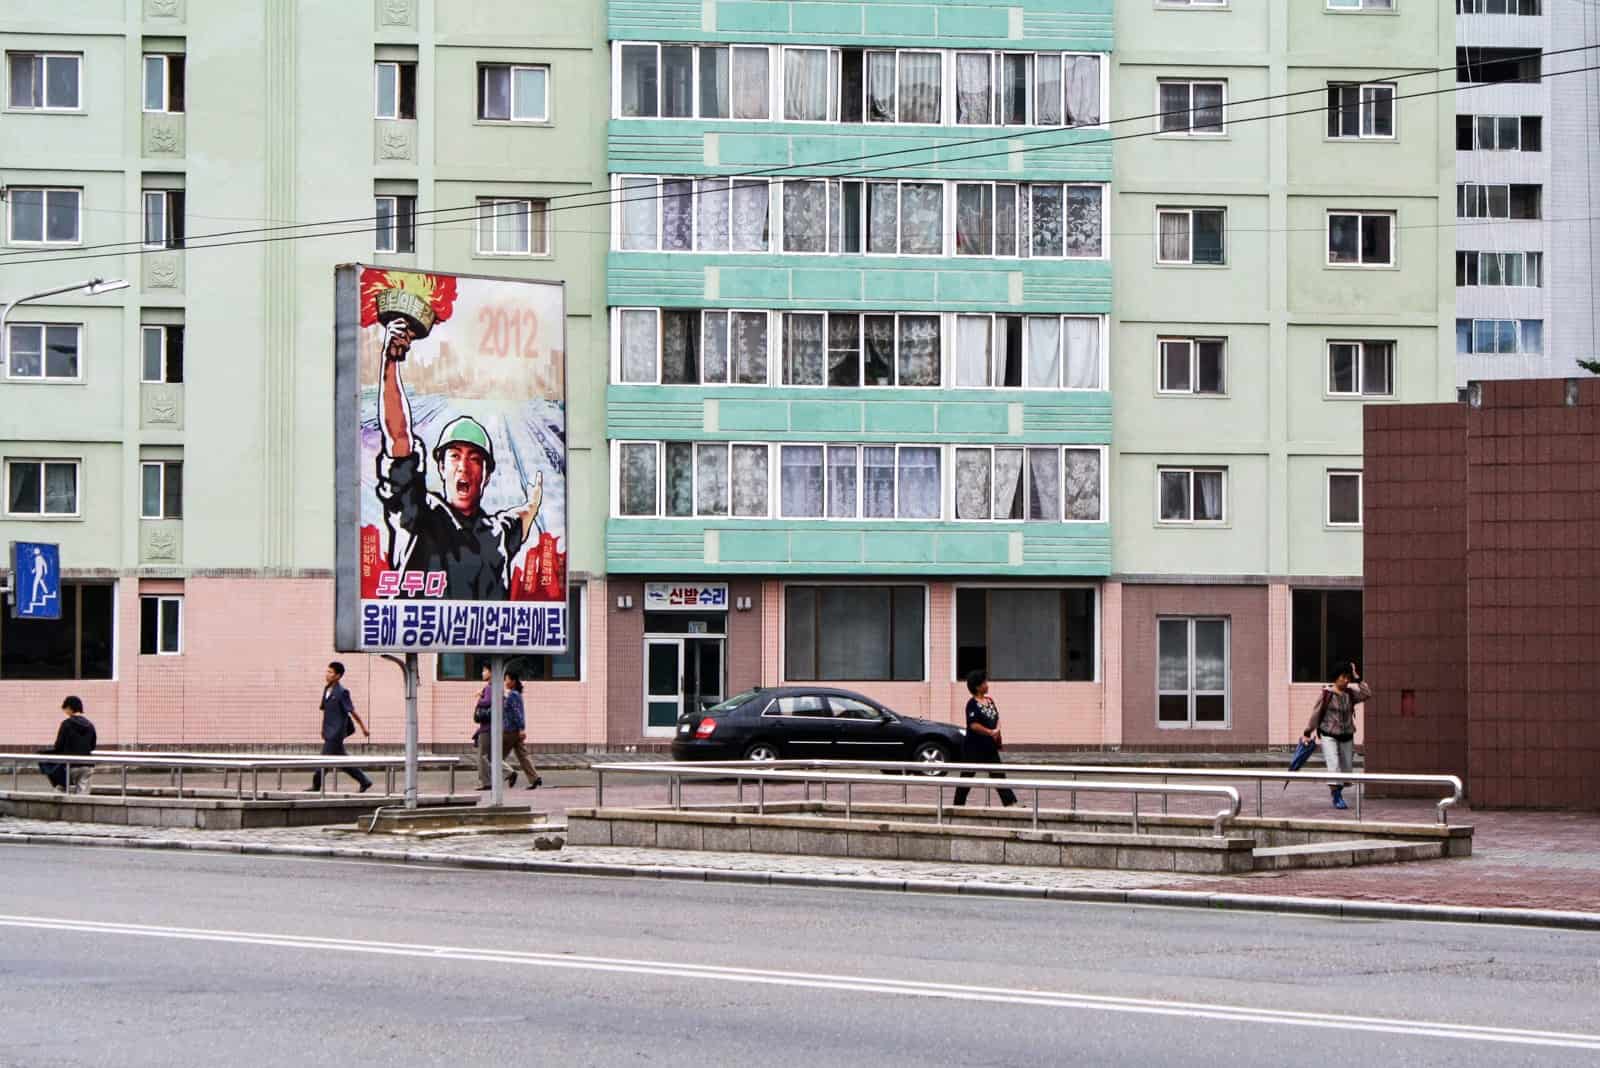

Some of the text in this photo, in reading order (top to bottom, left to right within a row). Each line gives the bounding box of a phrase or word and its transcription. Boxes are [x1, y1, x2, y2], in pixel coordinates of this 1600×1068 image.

[478, 306, 539, 358] 2012
[376, 571, 447, 597] 모두다
[363, 604, 397, 646] 올해
